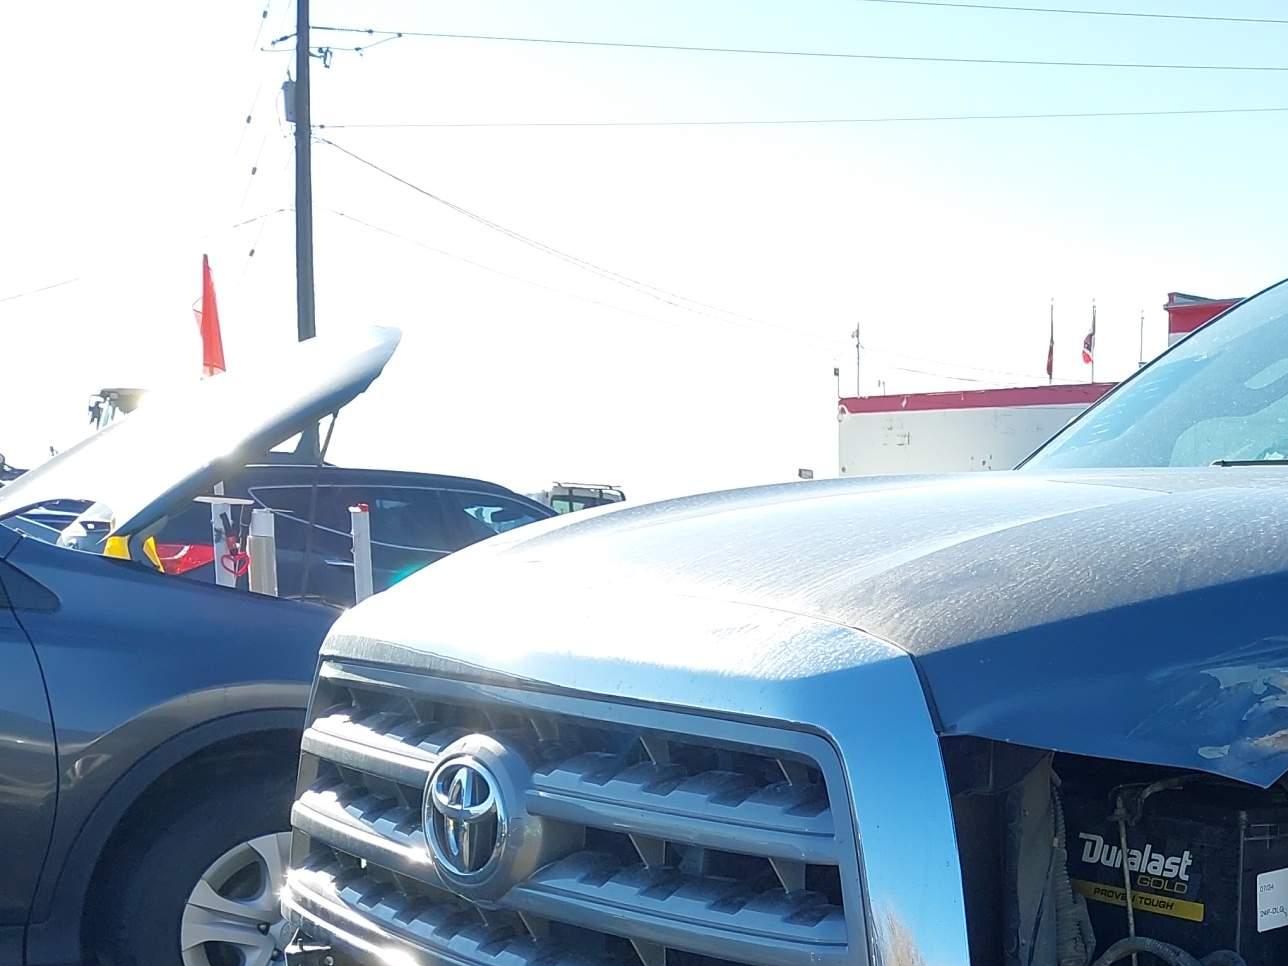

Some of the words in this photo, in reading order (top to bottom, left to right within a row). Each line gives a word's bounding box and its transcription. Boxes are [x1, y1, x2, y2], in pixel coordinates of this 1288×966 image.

[1078, 832, 1192, 881] Duralast
[1137, 875, 1188, 894] GOLD
[1139, 896, 1175, 911] TOUGH
